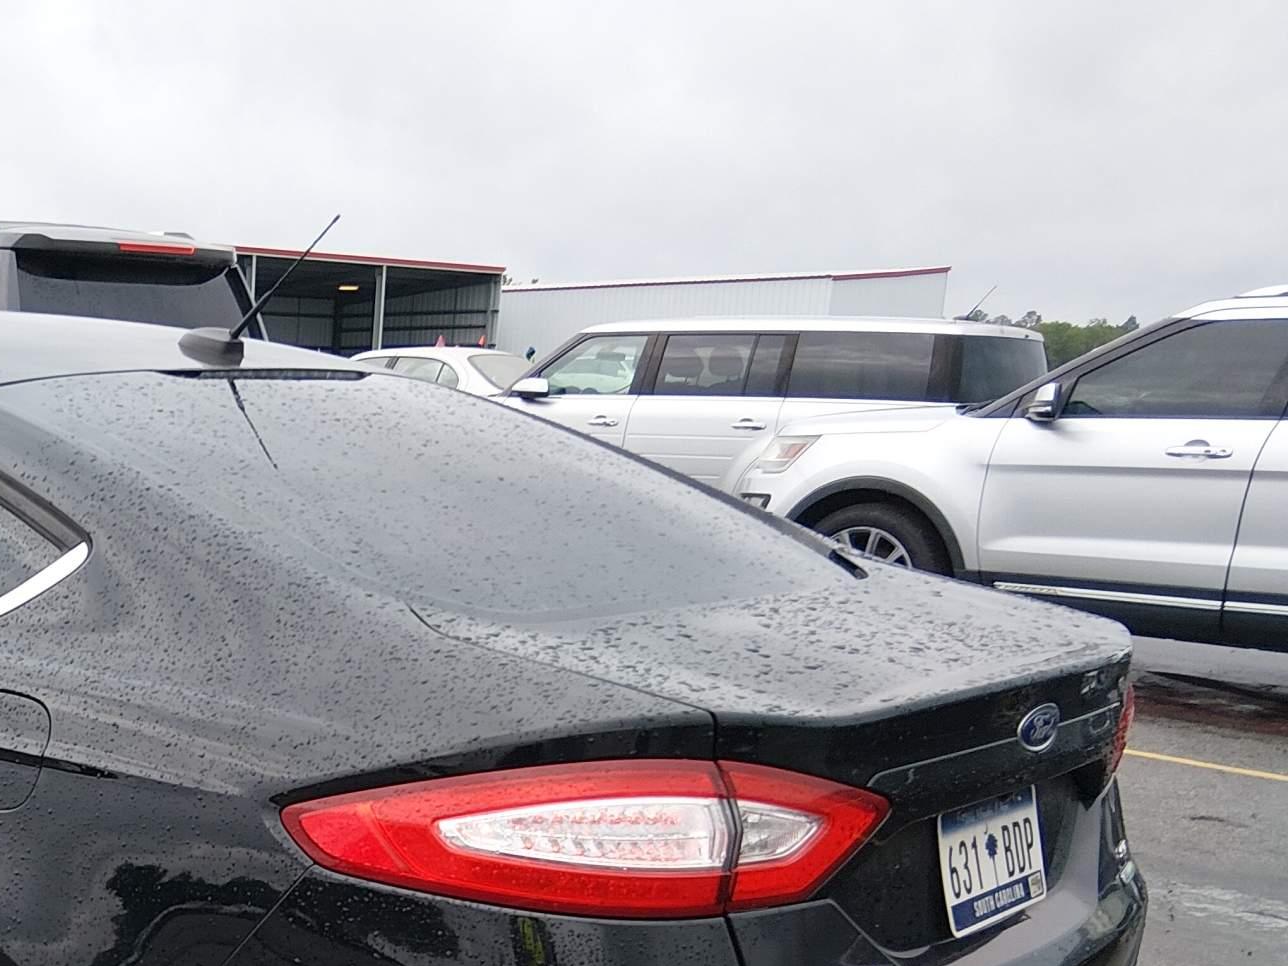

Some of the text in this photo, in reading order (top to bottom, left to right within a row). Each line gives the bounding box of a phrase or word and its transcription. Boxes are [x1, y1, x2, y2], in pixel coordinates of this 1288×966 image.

[948, 817, 1034, 899] 631 BDP
[973, 895, 996, 917] SOUTH
[994, 882, 1025, 908] CAROLINA
